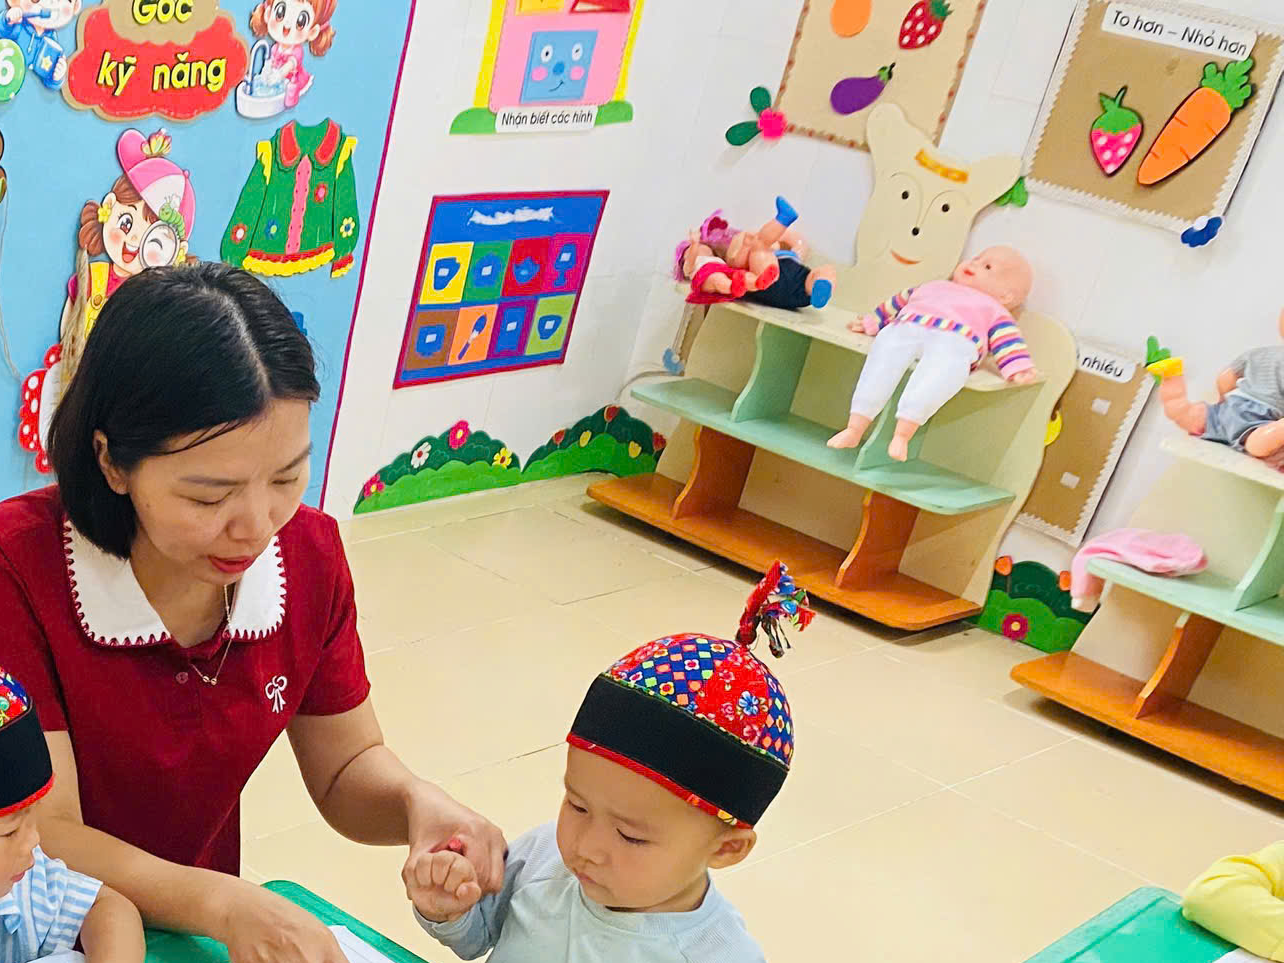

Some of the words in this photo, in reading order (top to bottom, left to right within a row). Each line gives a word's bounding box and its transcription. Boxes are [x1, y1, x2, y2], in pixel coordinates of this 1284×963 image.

[1112, 10, 1130, 28] To
[1132, 15, 1164, 36] hơn
[1181, 26, 1215, 48] Nhỏ
[1217, 35, 1247, 57] hơn
[95, 49, 137, 97] kỹ
[152, 51, 227, 93] năng
[501, 111, 528, 128] Nhận
[529, 109, 550, 125] biết
[551, 110, 571, 125] các
[572, 109, 593, 123] hình
